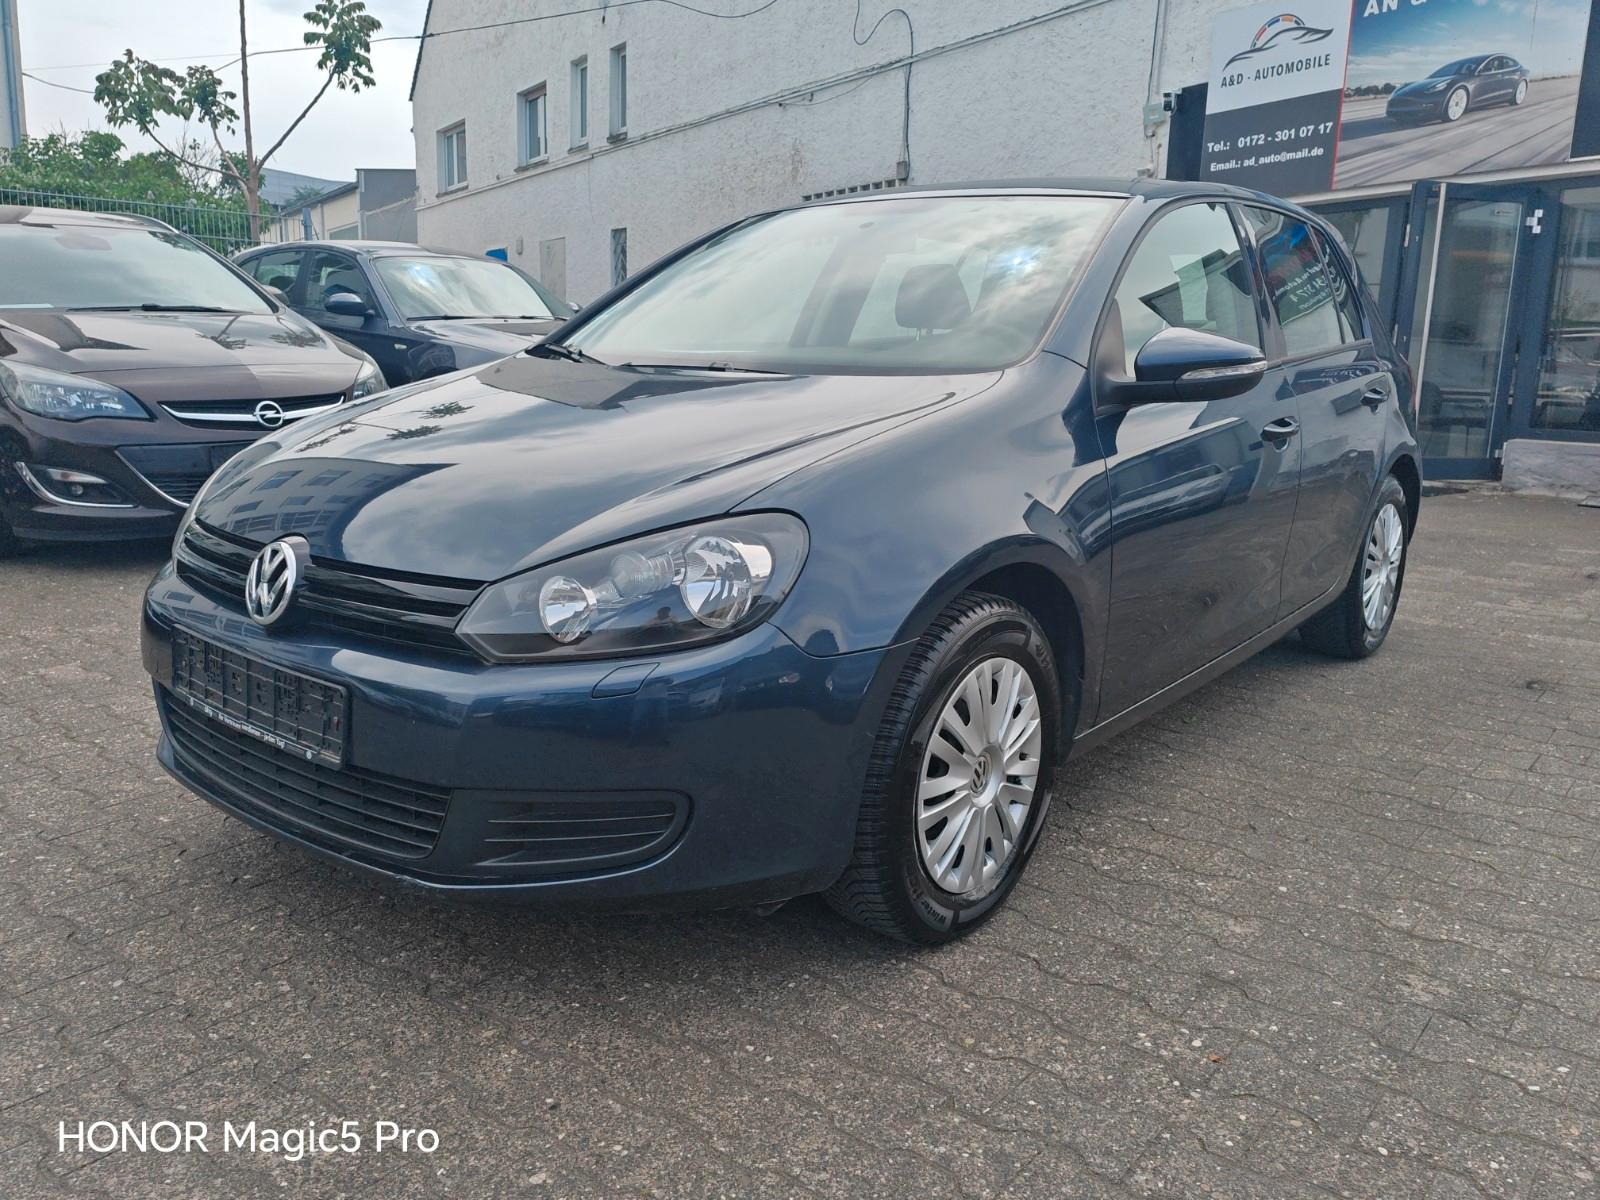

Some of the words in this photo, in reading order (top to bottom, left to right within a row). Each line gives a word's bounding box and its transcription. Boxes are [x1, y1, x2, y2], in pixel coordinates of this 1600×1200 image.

[1221, 73, 1244, 88] A&D
[1254, 53, 1331, 81] AUTOMOBILE
[1207, 141, 1230, 153] Tel.:
[1238, 134, 1265, 148] 0172
[1275, 128, 1296, 142] 301
[1299, 125, 1315, 138] 07
[1318, 122, 1333, 135] 17
[1210, 159, 1241, 172] Email.:
[1243, 147, 1324, 167] ad_auto@mail.de
